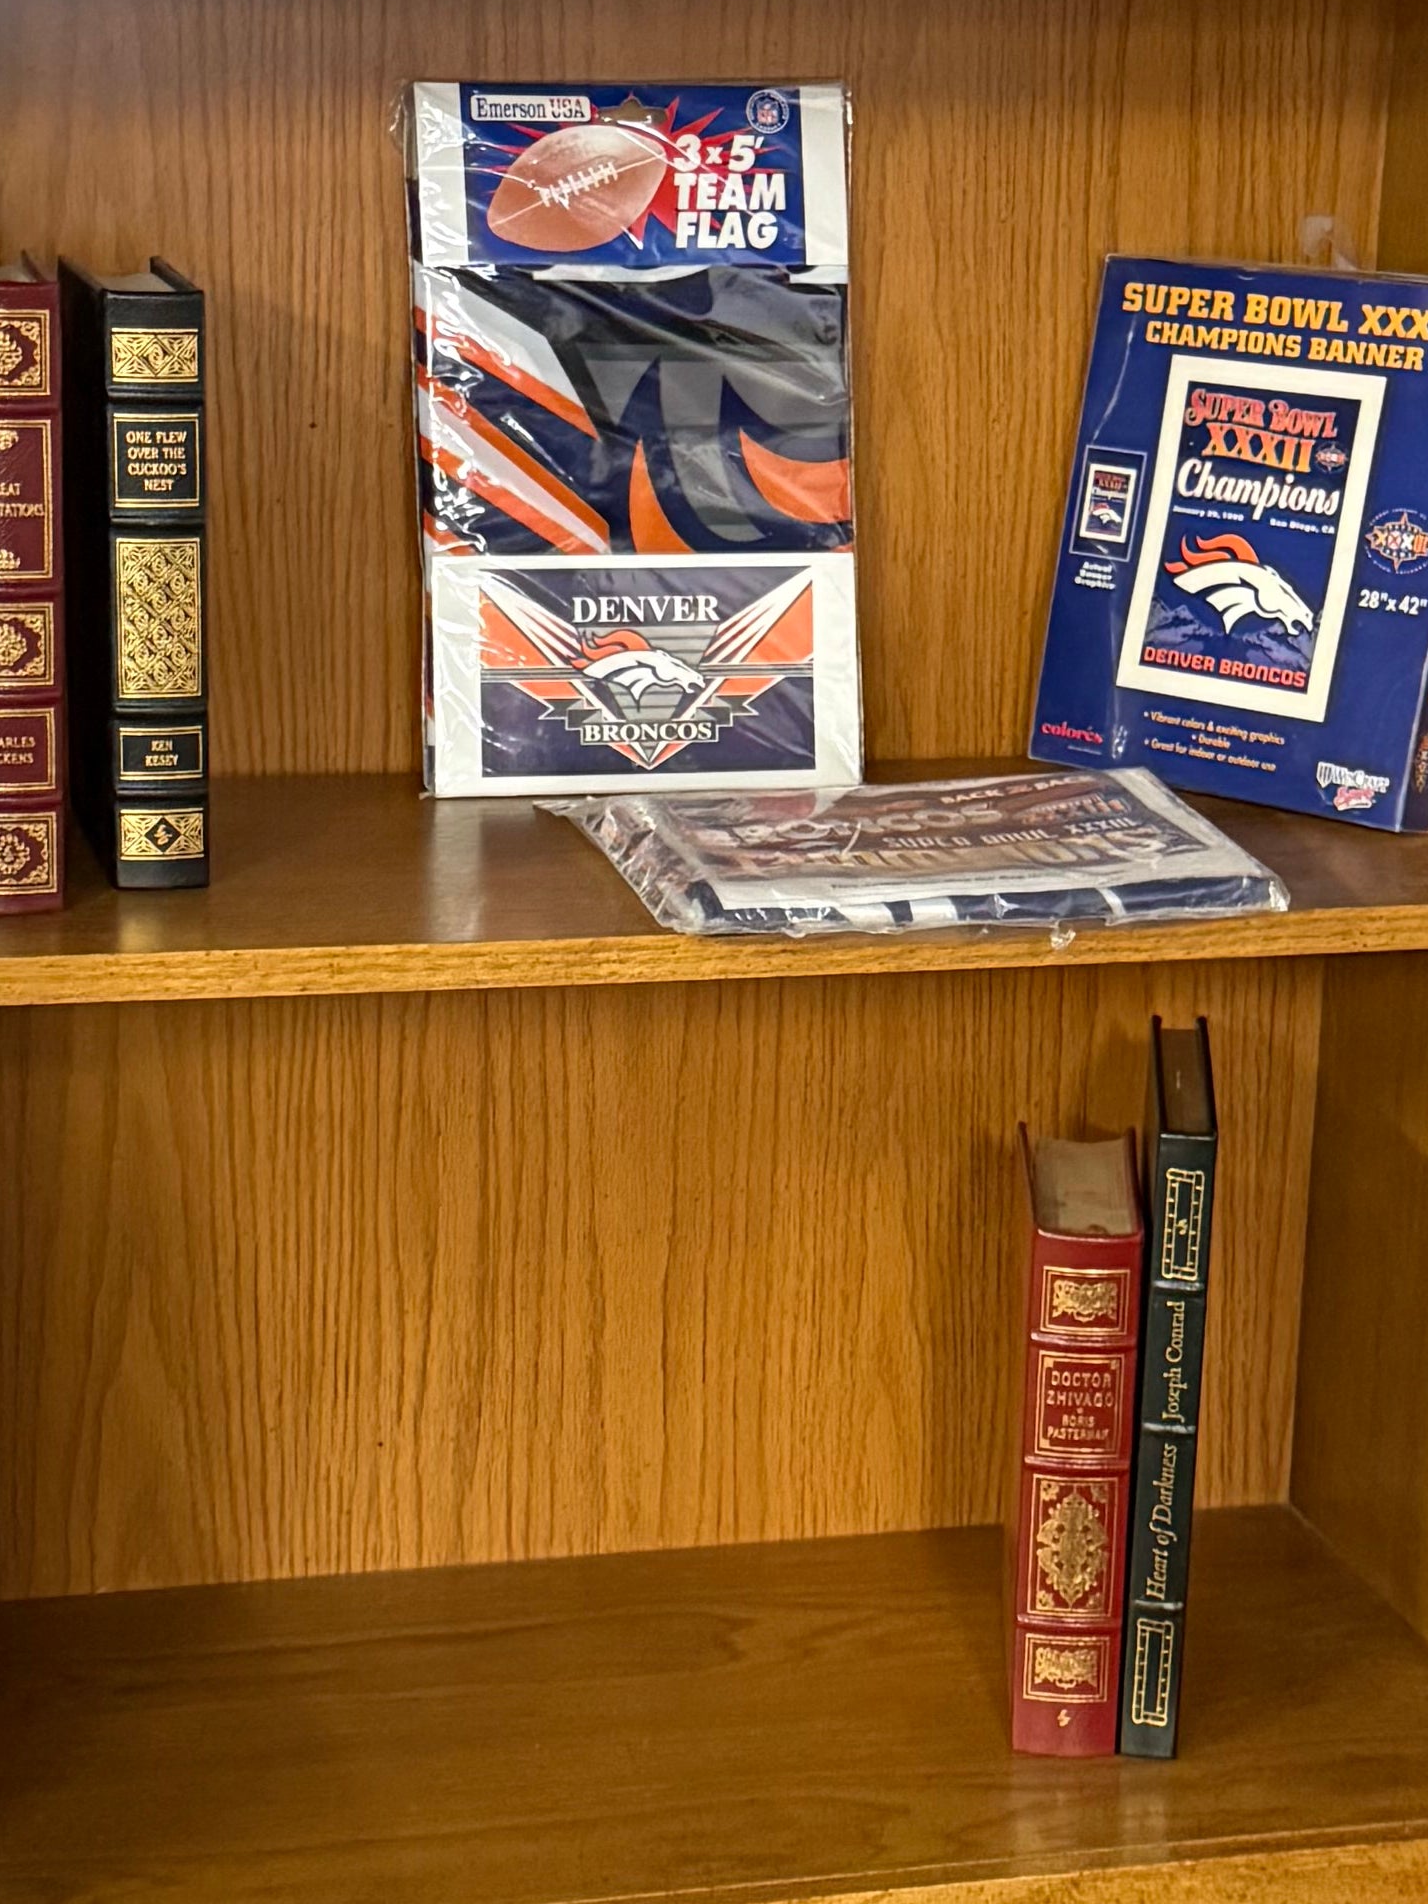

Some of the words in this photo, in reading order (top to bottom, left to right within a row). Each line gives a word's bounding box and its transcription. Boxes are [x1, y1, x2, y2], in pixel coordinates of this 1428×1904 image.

[476, 97, 547, 118] Emerson
[549, 98, 586, 118] USA
[673, 173, 786, 211] TEAM
[675, 212, 779, 250] FLAG
[1121, 281, 1236, 325] SUPER
[1243, 293, 1349, 333] BOWL
[1145, 321, 1302, 360] CHAMPIONS
[1307, 337, 1425, 373] BANNER
[125, 431, 152, 444] ONE
[155, 431, 187, 444] FLEW
[1200, 422, 1316, 474] XXXII
[127, 447, 159, 460] OVER
[162, 447, 186, 460] THE
[127, 462, 187, 475] CUCKOO'S
[144, 479, 174, 491] NEST
[1176, 457, 1341, 521] Champions
[571, 595, 721, 624] DENVER
[1143, 645, 1215, 674] DENVER
[1218, 657, 1308, 689] BRONCOS
[150, 739, 174, 752] KEN
[584, 721, 713, 743] BRONCOS
[144, 754, 179, 768] KESEY
[1165, 1300, 1186, 1363] Conrad
[1051, 1370, 1112, 1388] DOCTOR
[1162, 1364, 1188, 1422] Joseph
[1046, 1389, 1114, 1408] ZHIVAGO
[1152, 1443, 1178, 1526] Darkness
[1150, 1517, 1178, 1546] of
[1145, 1549, 1169, 1601] Heart
